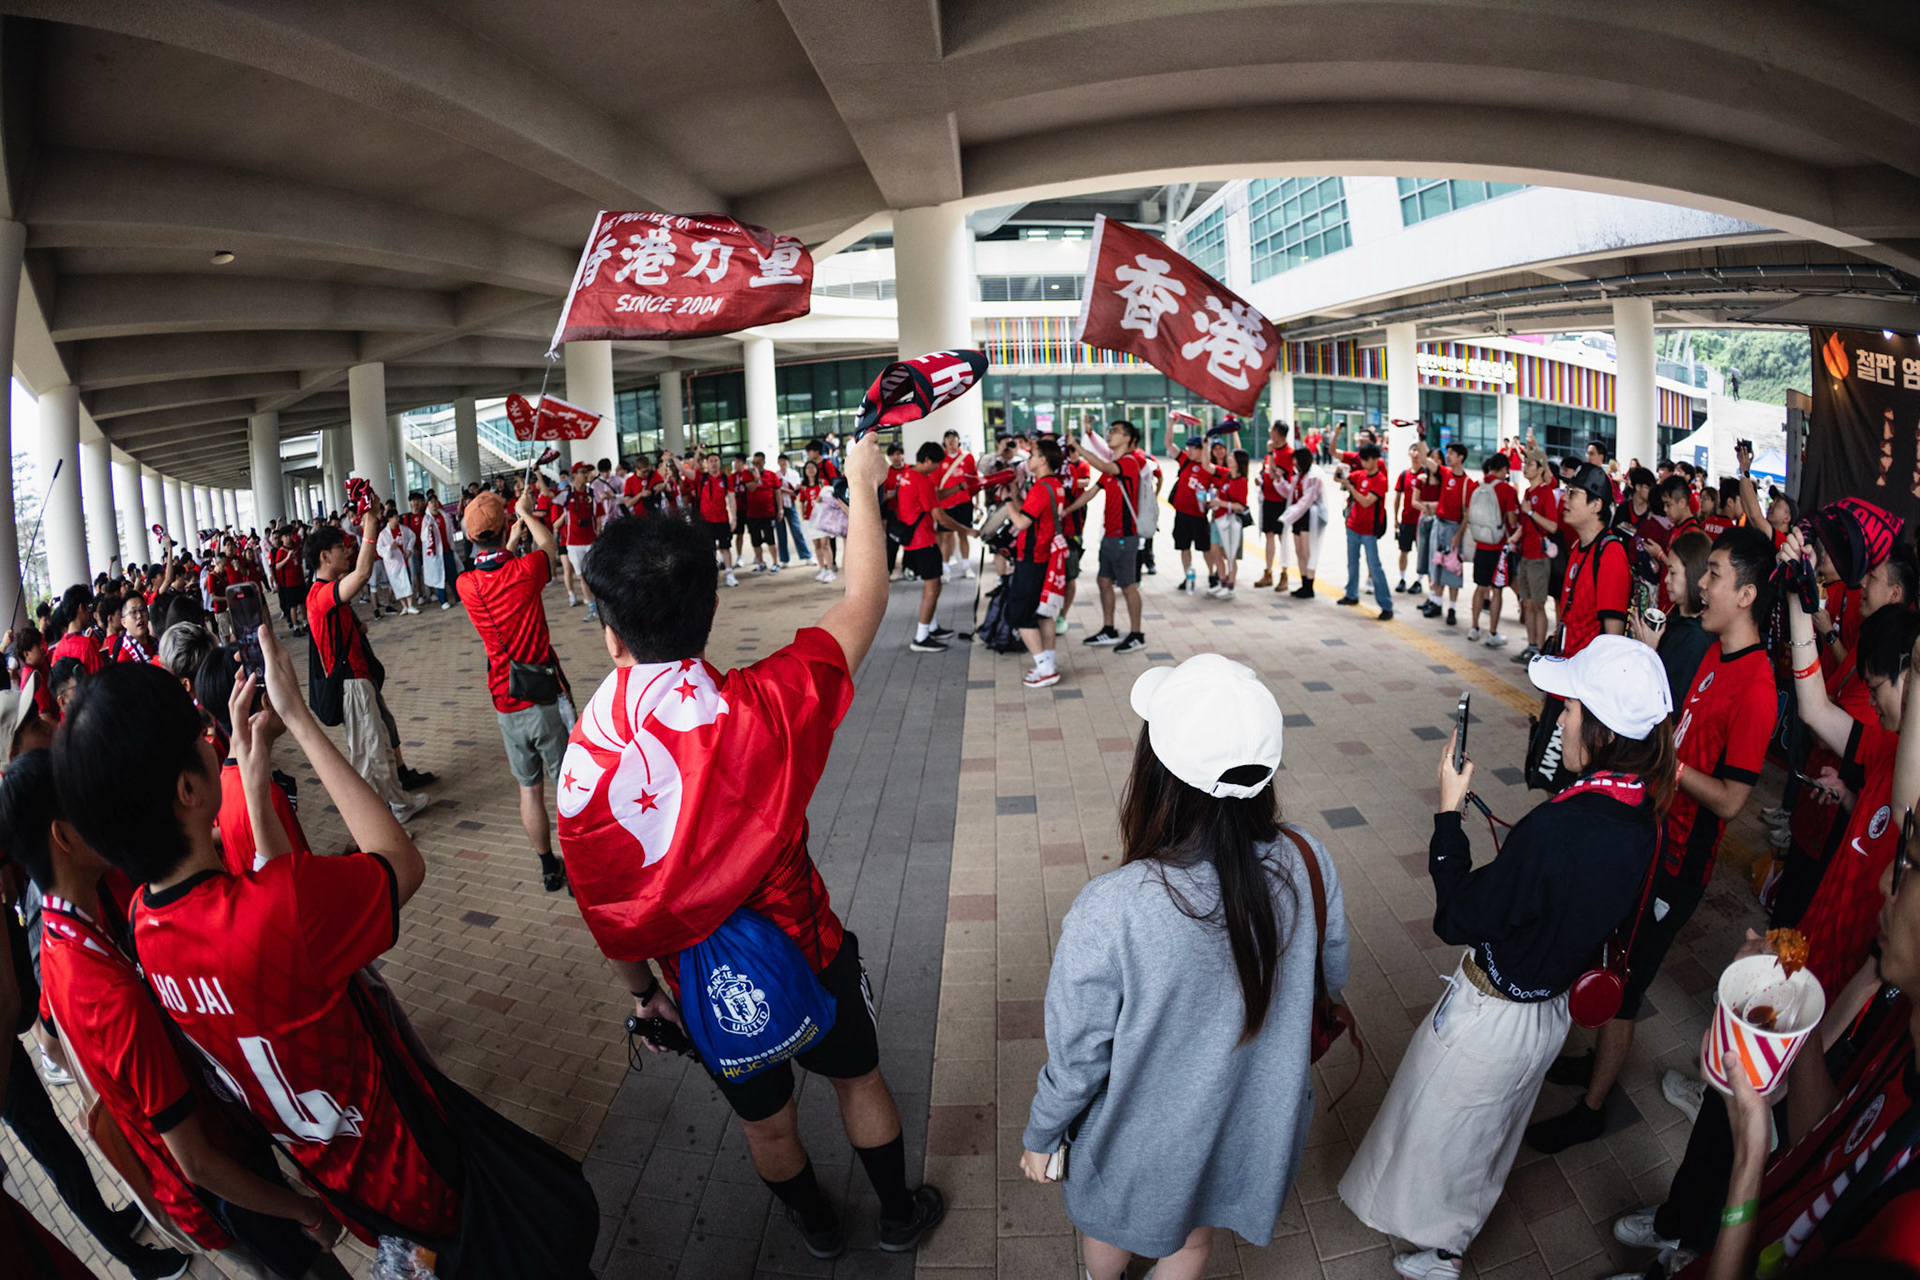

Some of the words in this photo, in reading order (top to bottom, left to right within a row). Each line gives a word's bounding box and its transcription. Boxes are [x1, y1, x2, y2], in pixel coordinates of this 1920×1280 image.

[614, 294, 677, 313] SINCE
[676, 295, 725, 315] 2004
[1113, 253, 1267, 390] 香港
[1856, 348, 1896, 386] 철판
[1538, 720, 1563, 782] ARMY
[187, 976, 235, 1015] JAI
[732, 1010, 769, 1033] UNITED
[722, 1060, 765, 1079] HKJC
